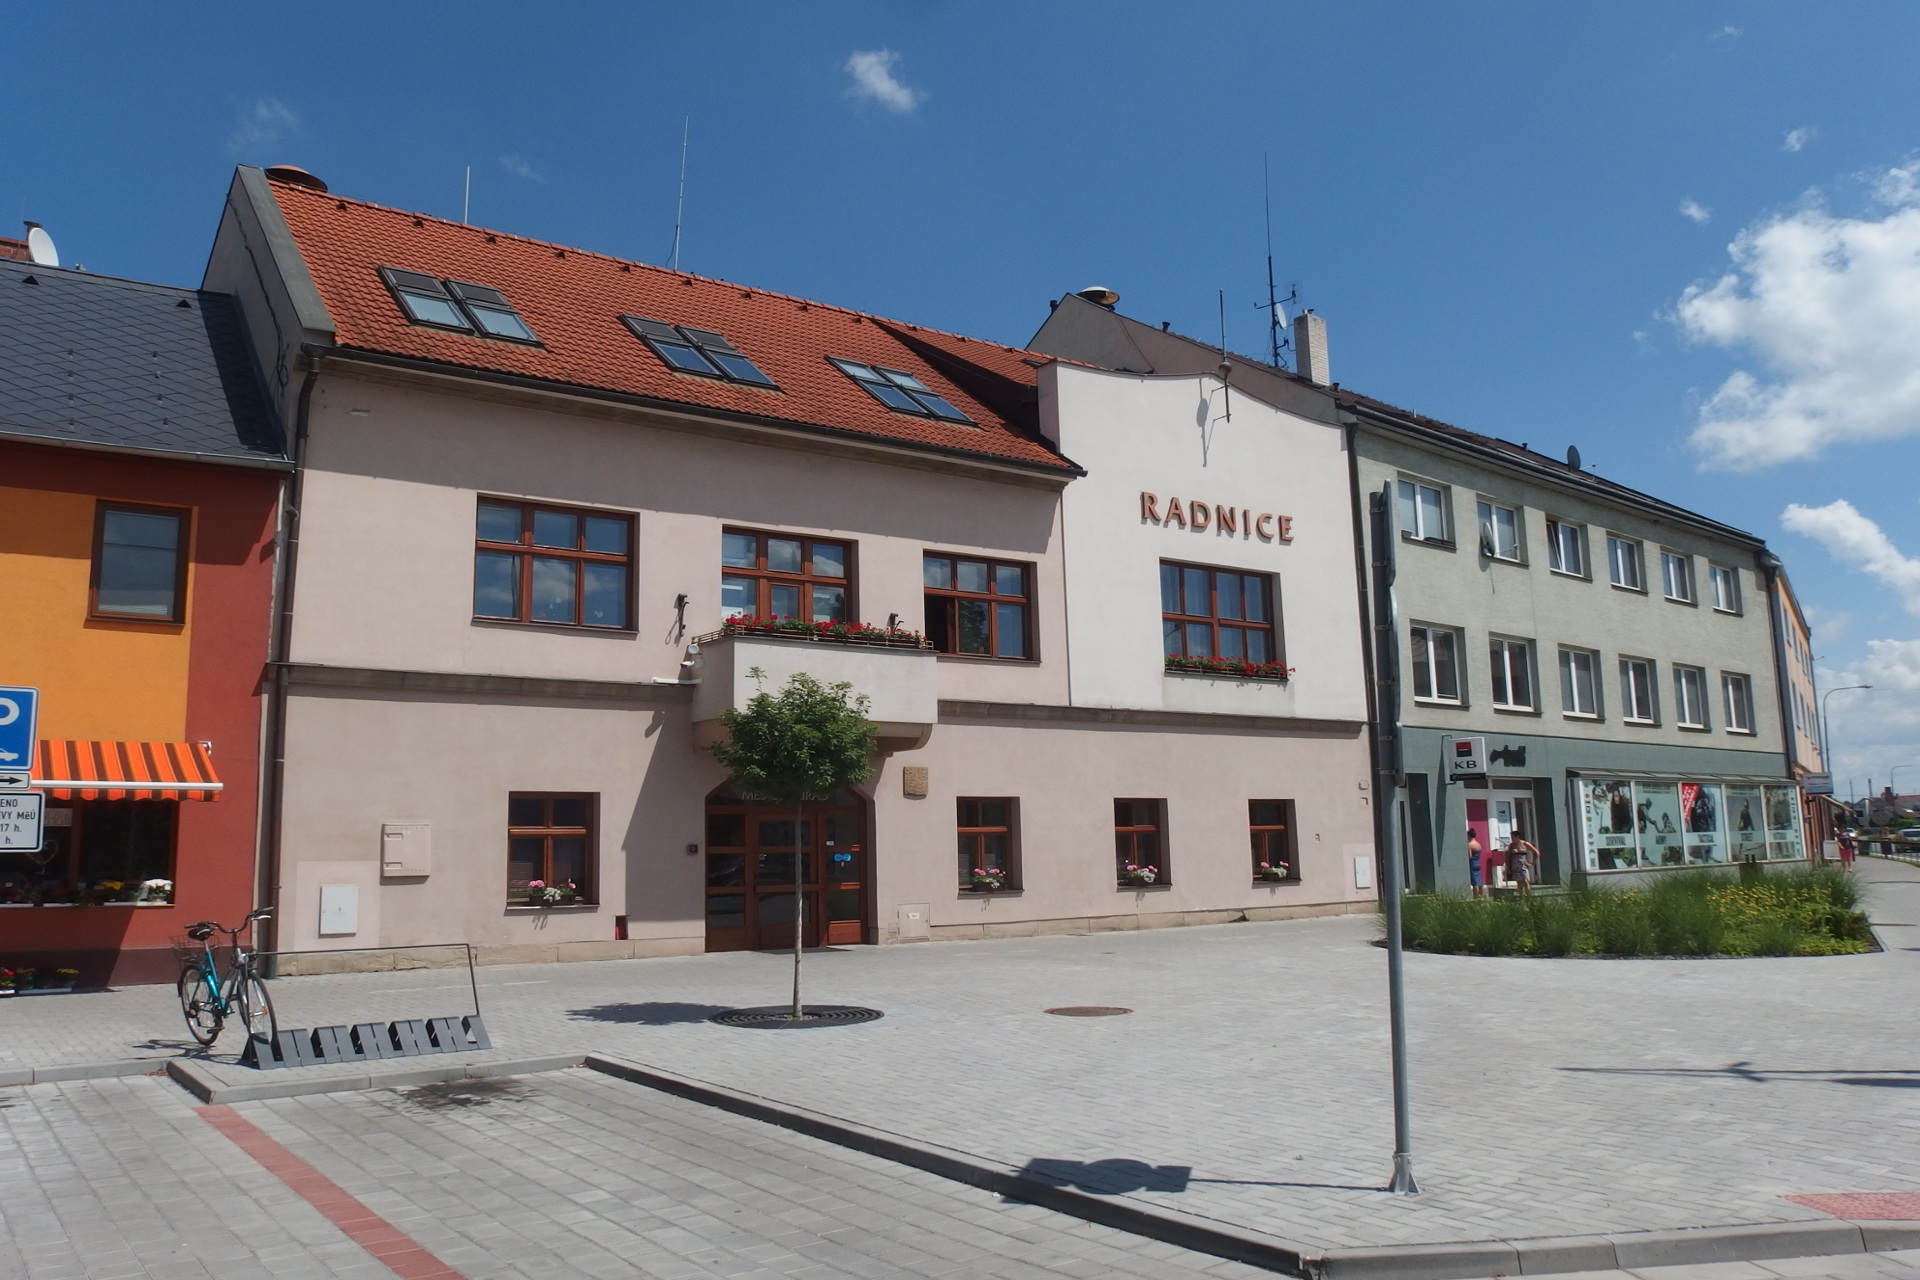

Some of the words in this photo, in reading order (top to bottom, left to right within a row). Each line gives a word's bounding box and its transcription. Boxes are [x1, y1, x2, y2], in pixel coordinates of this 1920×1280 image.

[1141, 491, 1295, 542] RADNICE
[1454, 760, 1477, 769] KB
[17, 809, 36, 820] MěÚ
[14, 823, 22, 832] h.
